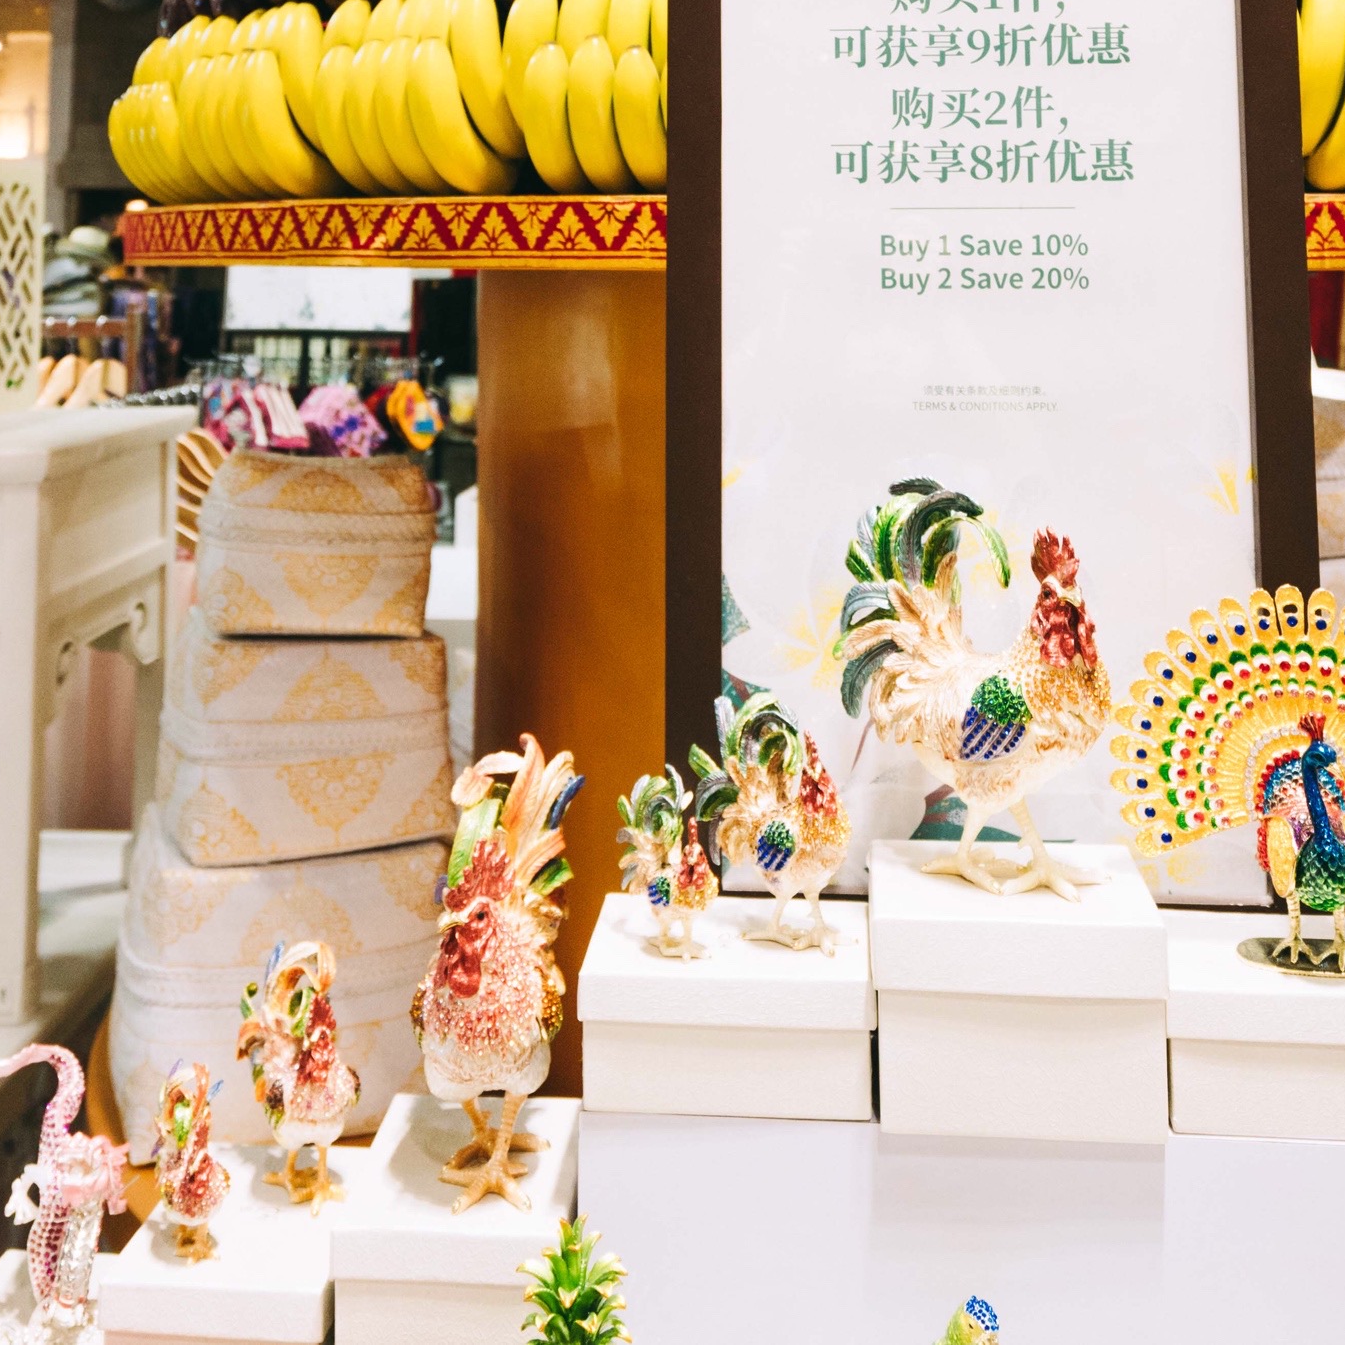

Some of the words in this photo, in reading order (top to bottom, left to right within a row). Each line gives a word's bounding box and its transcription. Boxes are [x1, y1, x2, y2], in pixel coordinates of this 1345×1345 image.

[830, 21, 1132, 69] 可获享9折优惠
[831, 138, 1135, 185] 可获享8折优惠
[880, 234, 931, 264] Buy
[938, 235, 953, 257] 1
[960, 234, 1024, 258] Save
[1031, 234, 1090, 258] 10%
[880, 267, 932, 297] Buy
[938, 268, 953, 291] 2
[960, 267, 1024, 291] Save
[1031, 267, 1091, 291] 20%
[912, 401, 948, 413] TERMS
[949, 401, 958, 413] &
[959, 401, 1025, 413] CONDITIONS
